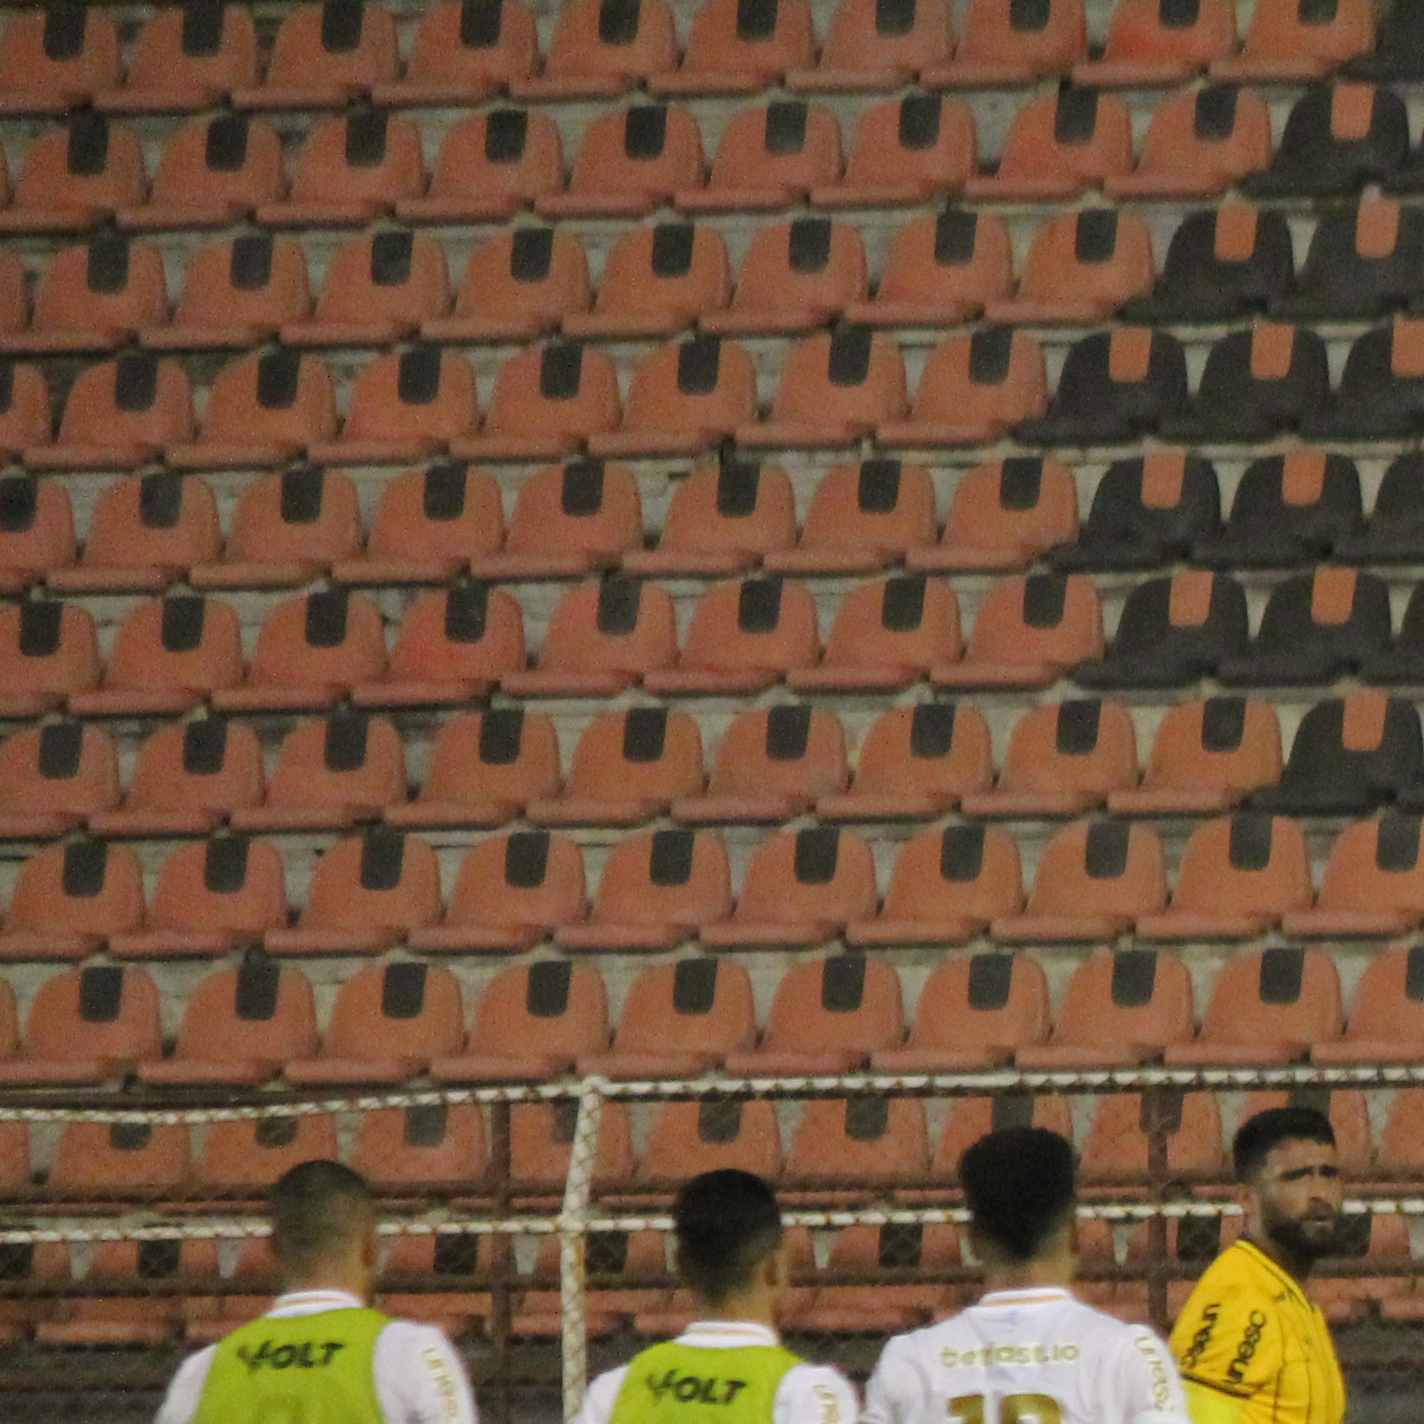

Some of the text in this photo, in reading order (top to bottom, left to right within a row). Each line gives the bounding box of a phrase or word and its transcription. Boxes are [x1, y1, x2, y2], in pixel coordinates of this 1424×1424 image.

[237, 1340, 346, 1374] VOLT
[1223, 1308, 1268, 1385] unesc
[645, 1368, 747, 1405] VOLT
